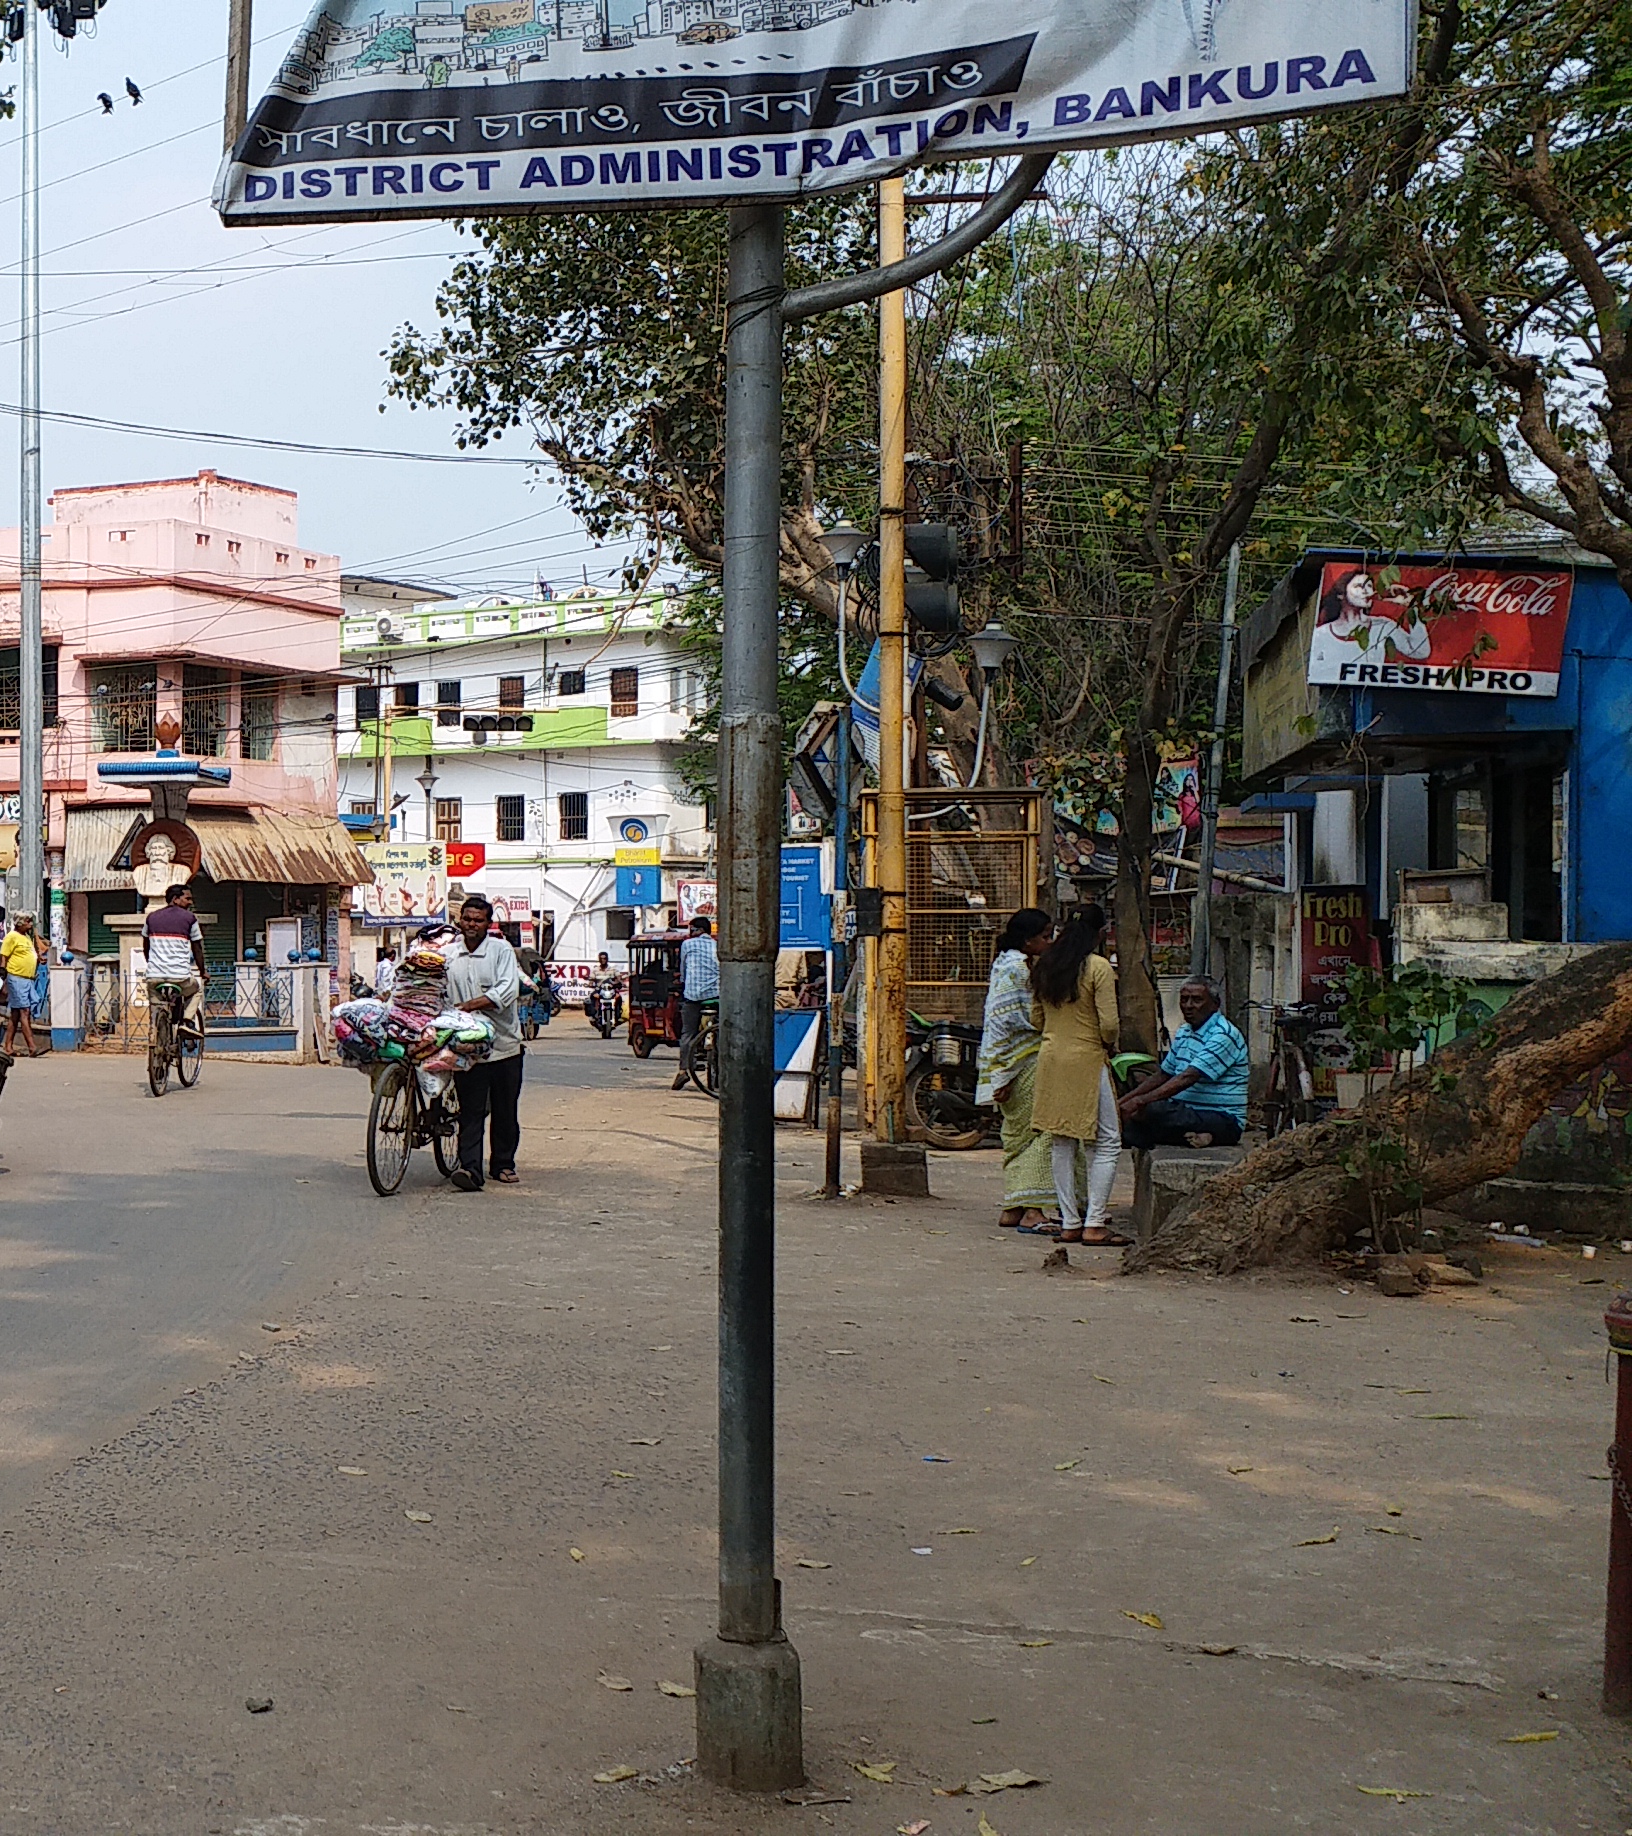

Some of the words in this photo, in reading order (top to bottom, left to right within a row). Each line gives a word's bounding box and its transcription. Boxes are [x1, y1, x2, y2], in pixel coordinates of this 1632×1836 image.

[256, 118, 461, 156] সাবধানে
[473, 104, 641, 141] চালাও,
[659, 87, 817, 129] জীবন
[829, 60, 983, 109] বাঁচাও
[244, 160, 501, 203] DISTRICT
[519, 101, 1030, 189] ADMINISTRATION,
[1053, 48, 1378, 127] BANKURA
[1339, 663, 1446, 686] FRESH
[1465, 670, 1533, 691] PRO
[509, 900, 530, 910] EXIDE
[1303, 891, 1363, 919] Fresh
[1314, 920, 1352, 947] Pro
